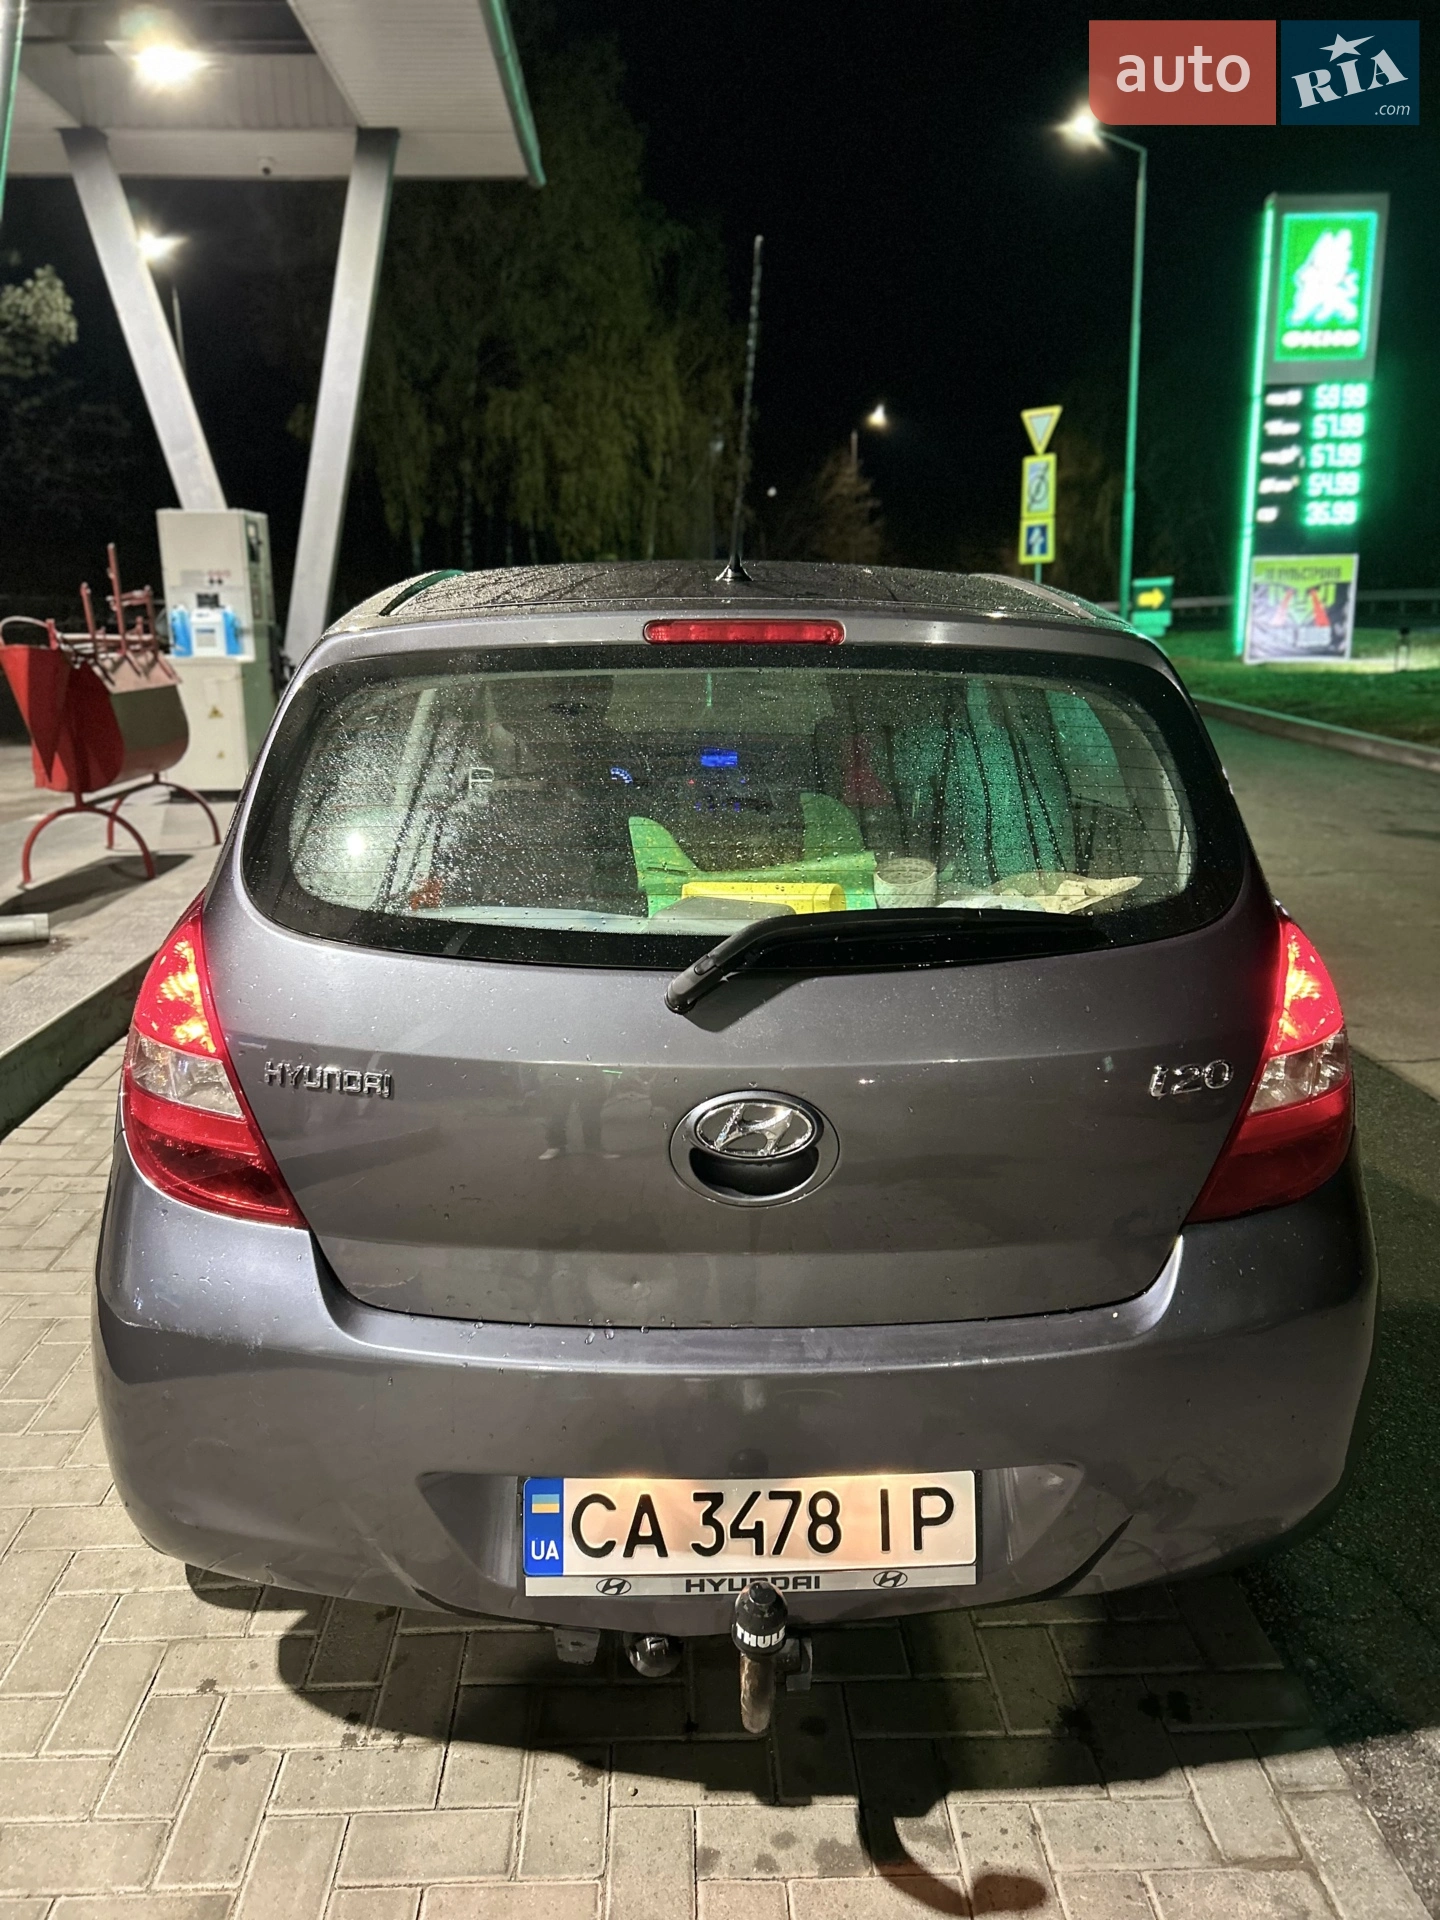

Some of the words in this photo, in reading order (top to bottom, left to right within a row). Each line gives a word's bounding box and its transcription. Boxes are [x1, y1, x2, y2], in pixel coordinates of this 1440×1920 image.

[264, 1061, 392, 1098] HYUNDAI
[571, 1493, 668, 1559] CA
[691, 1489, 842, 1557] 3478
[880, 1487, 955, 1552] IP
[531, 1540, 559, 1560] UA
[685, 1575, 821, 1593] HYUDAI
